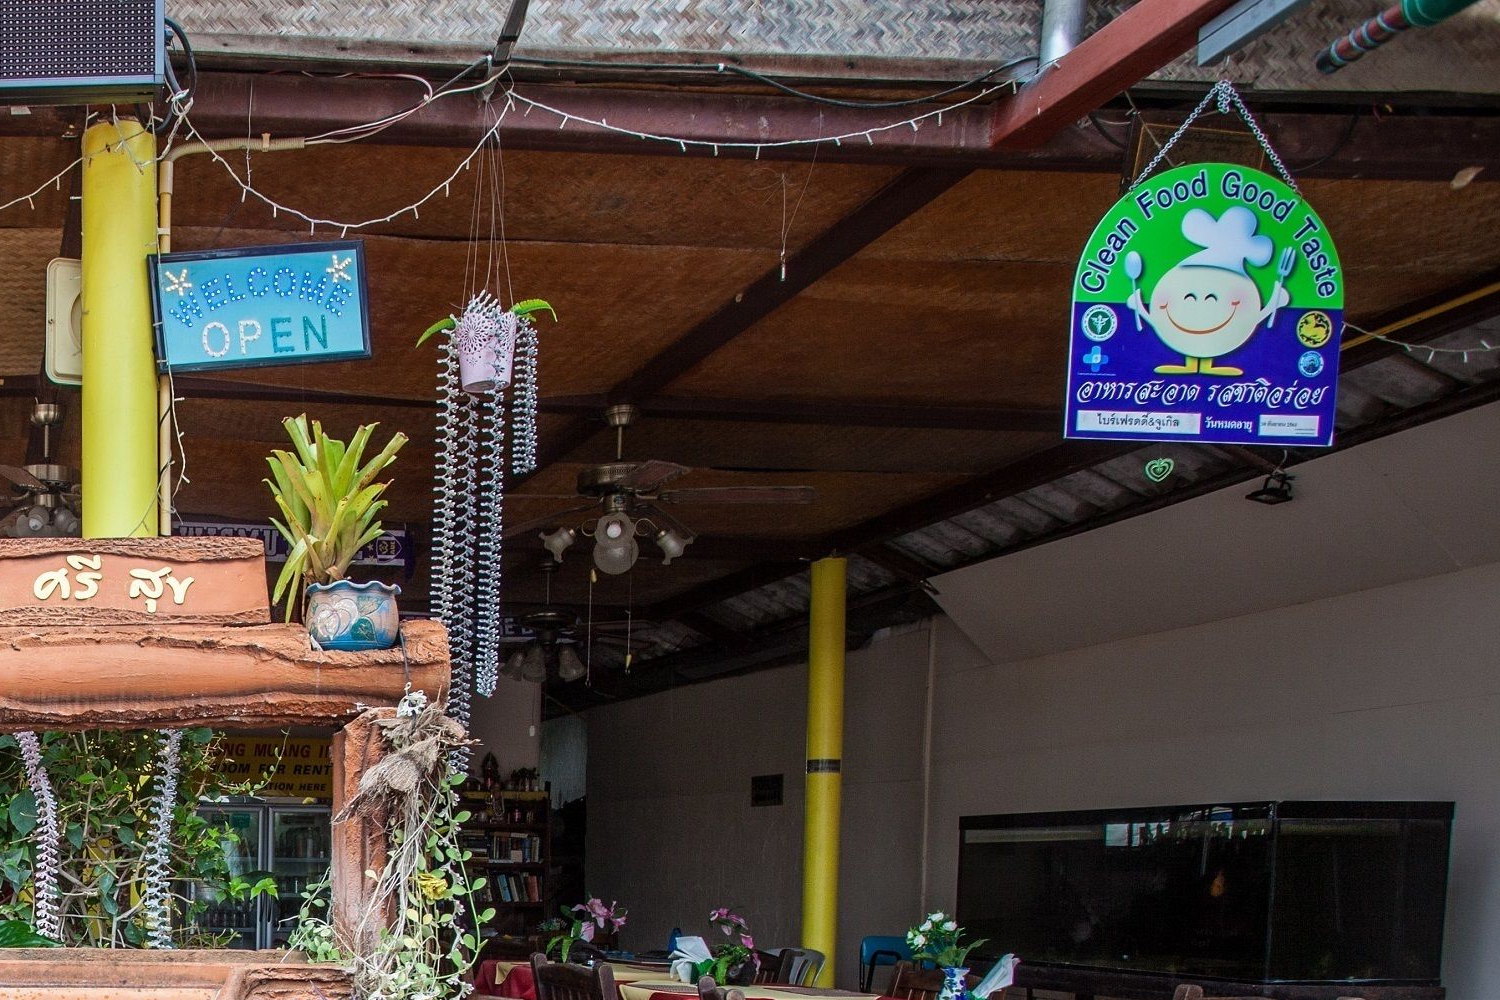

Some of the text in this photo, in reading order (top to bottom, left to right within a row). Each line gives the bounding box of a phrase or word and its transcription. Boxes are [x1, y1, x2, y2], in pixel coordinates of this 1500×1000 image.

[1080, 169, 1337, 297] Clean Food Good Taste
[169, 267, 352, 327] WELCOME
[202, 315, 328, 358] OPEN
[1077, 377, 1329, 409] อาหารสะอาด รสชาติอร่อย
[1205, 417, 1253, 433] วันหมดอายุ
[33, 554, 102, 600] ศรี
[129, 566, 195, 613] สุข
[293, 764, 333, 775] RENT
[299, 783, 326, 791] HERE
